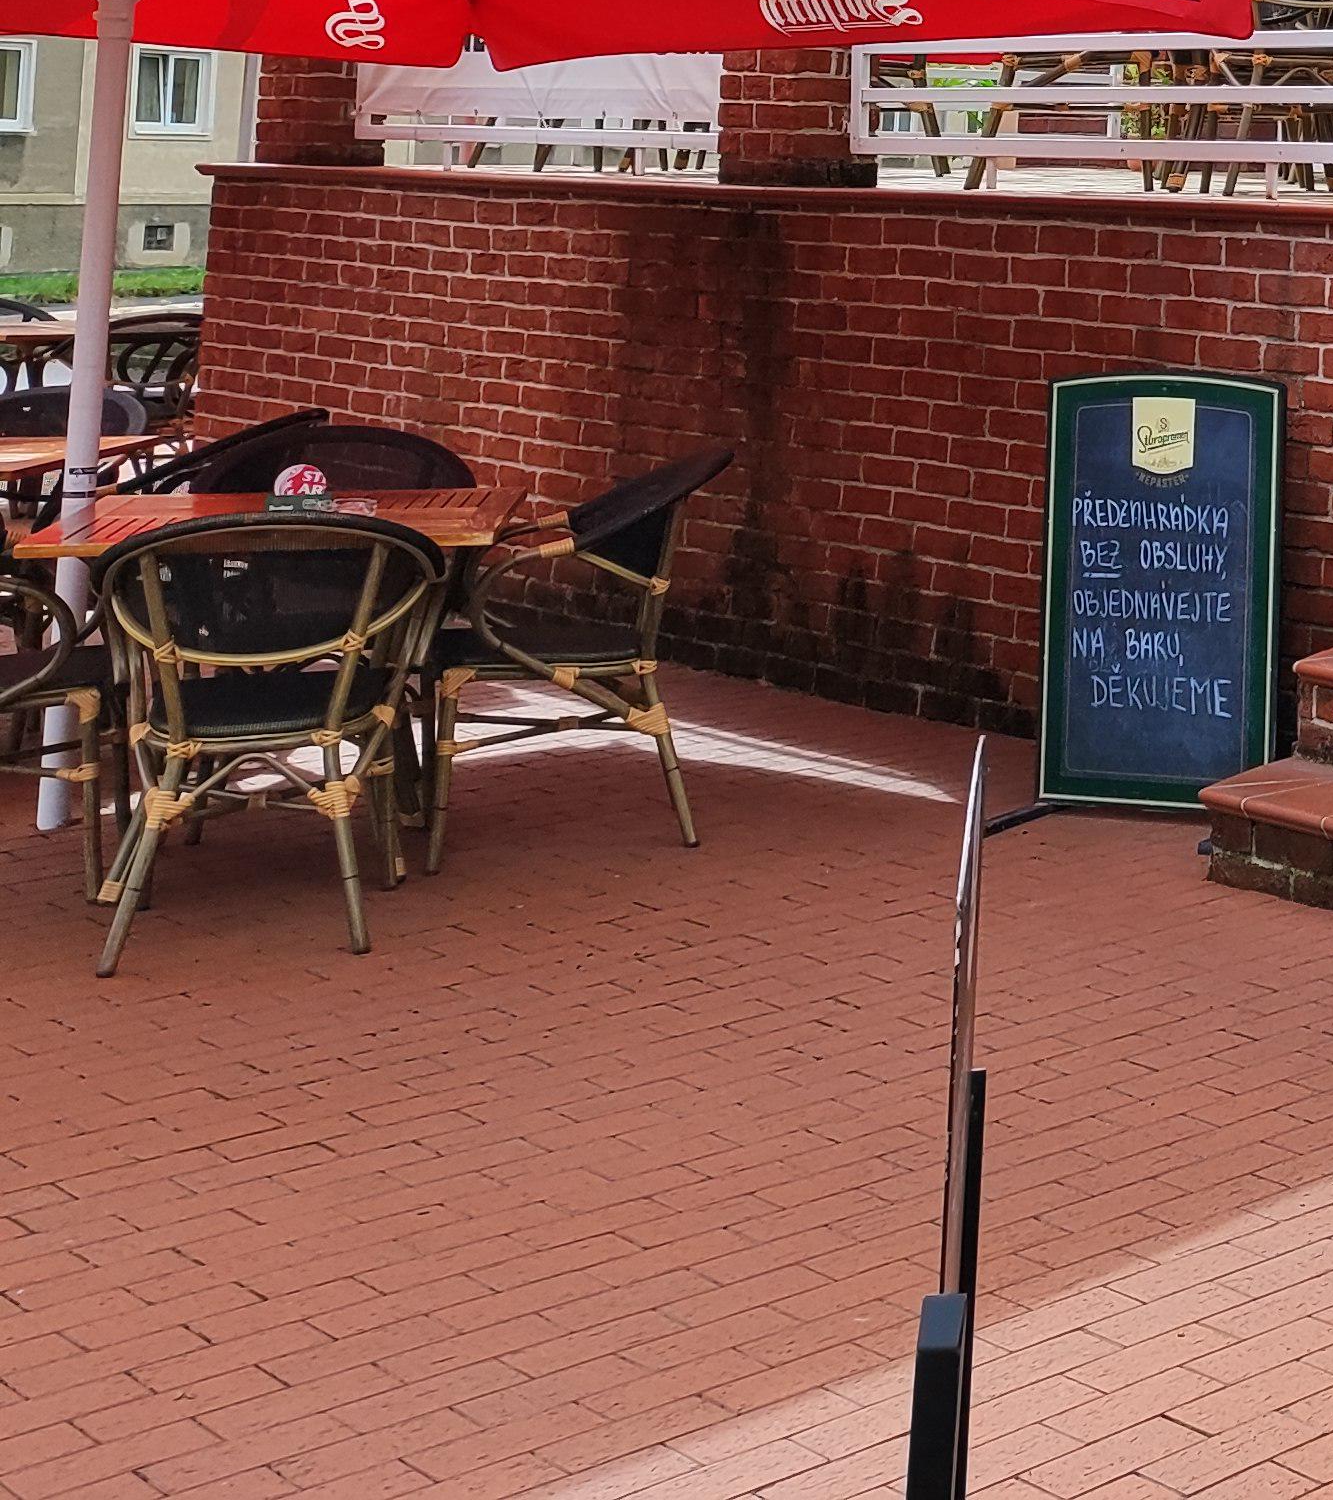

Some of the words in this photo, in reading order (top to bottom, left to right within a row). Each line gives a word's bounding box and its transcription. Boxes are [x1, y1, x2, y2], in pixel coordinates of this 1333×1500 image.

[1072, 490, 1229, 539] PŘEDZAHRÁDKA
[1080, 540, 1123, 570] BEZ
[1140, 540, 1228, 580] OBSLUHY,
[1073, 581, 1232, 623] OBJEDNÁVEJTE
[1072, 627, 1105, 666] NA
[1125, 628, 1184, 667] BARU,
[1091, 663, 1232, 718] DĚKUJEME
